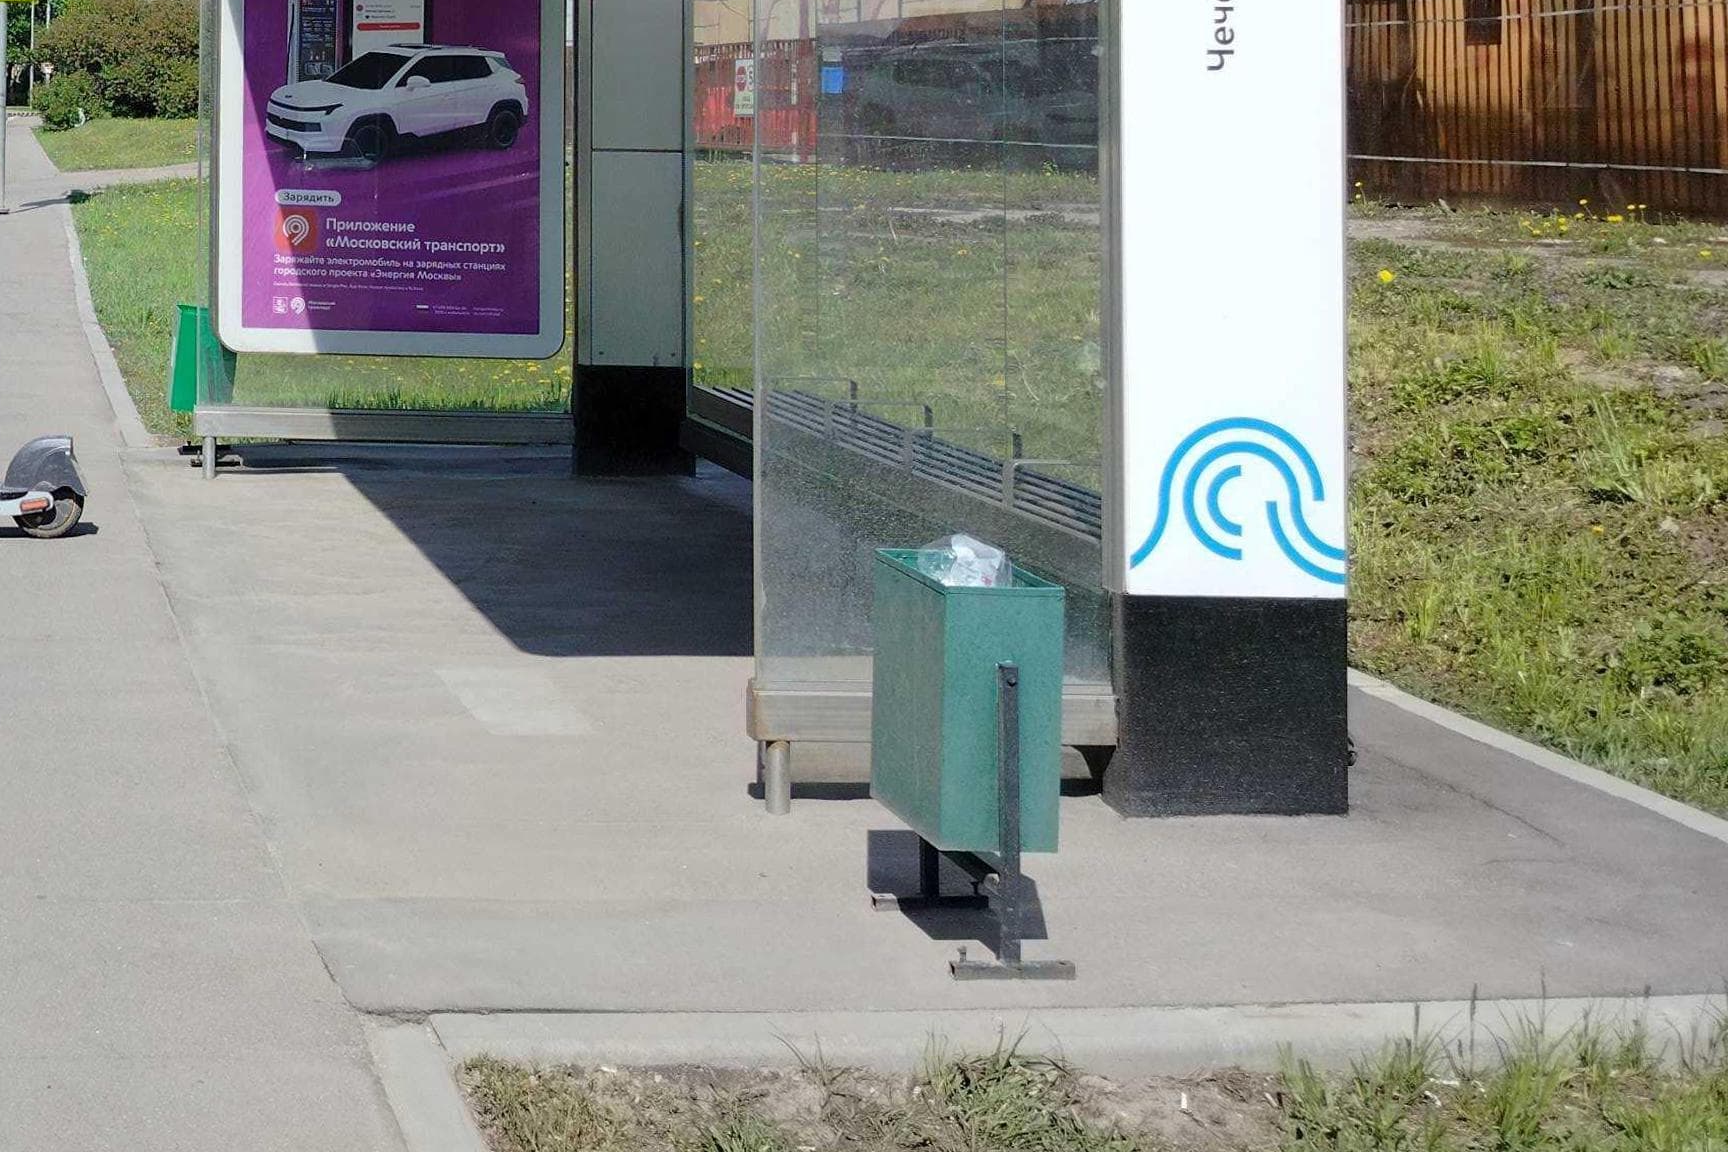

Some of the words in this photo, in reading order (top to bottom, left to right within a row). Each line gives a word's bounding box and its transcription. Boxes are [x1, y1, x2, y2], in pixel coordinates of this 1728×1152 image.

[283, 192, 335, 203] Зарядить
[325, 217, 415, 233] Приложение
[325, 235, 421, 250] «Московский
[424, 240, 506, 255] транспорт»
[273, 253, 325, 266] Заряжайте
[326, 255, 401, 268] электромобиль
[403, 259, 414, 268] на
[416, 260, 461, 270] зарядных
[463, 261, 506, 271] станциях
[273, 267, 327, 278] городского
[329, 268, 368, 278] проекта
